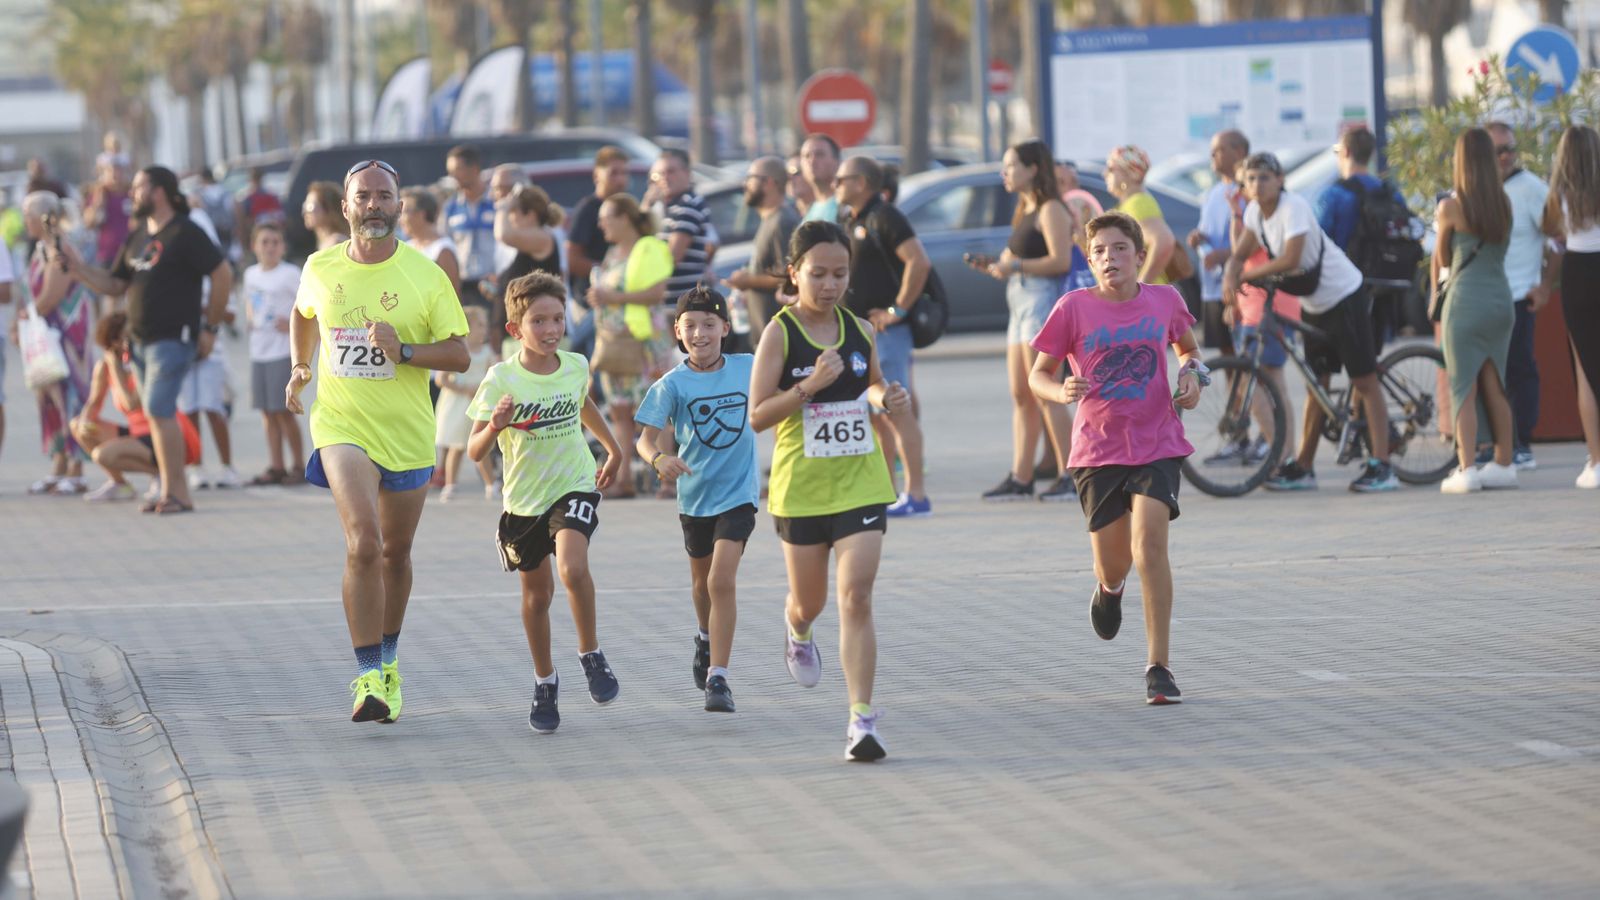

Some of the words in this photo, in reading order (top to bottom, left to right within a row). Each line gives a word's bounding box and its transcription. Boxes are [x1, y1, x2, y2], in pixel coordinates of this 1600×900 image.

[337, 345, 386, 367] 728
[538, 392, 571, 402] CALIFORNIA
[814, 420, 866, 444] 465
[565, 499, 594, 524] 10
